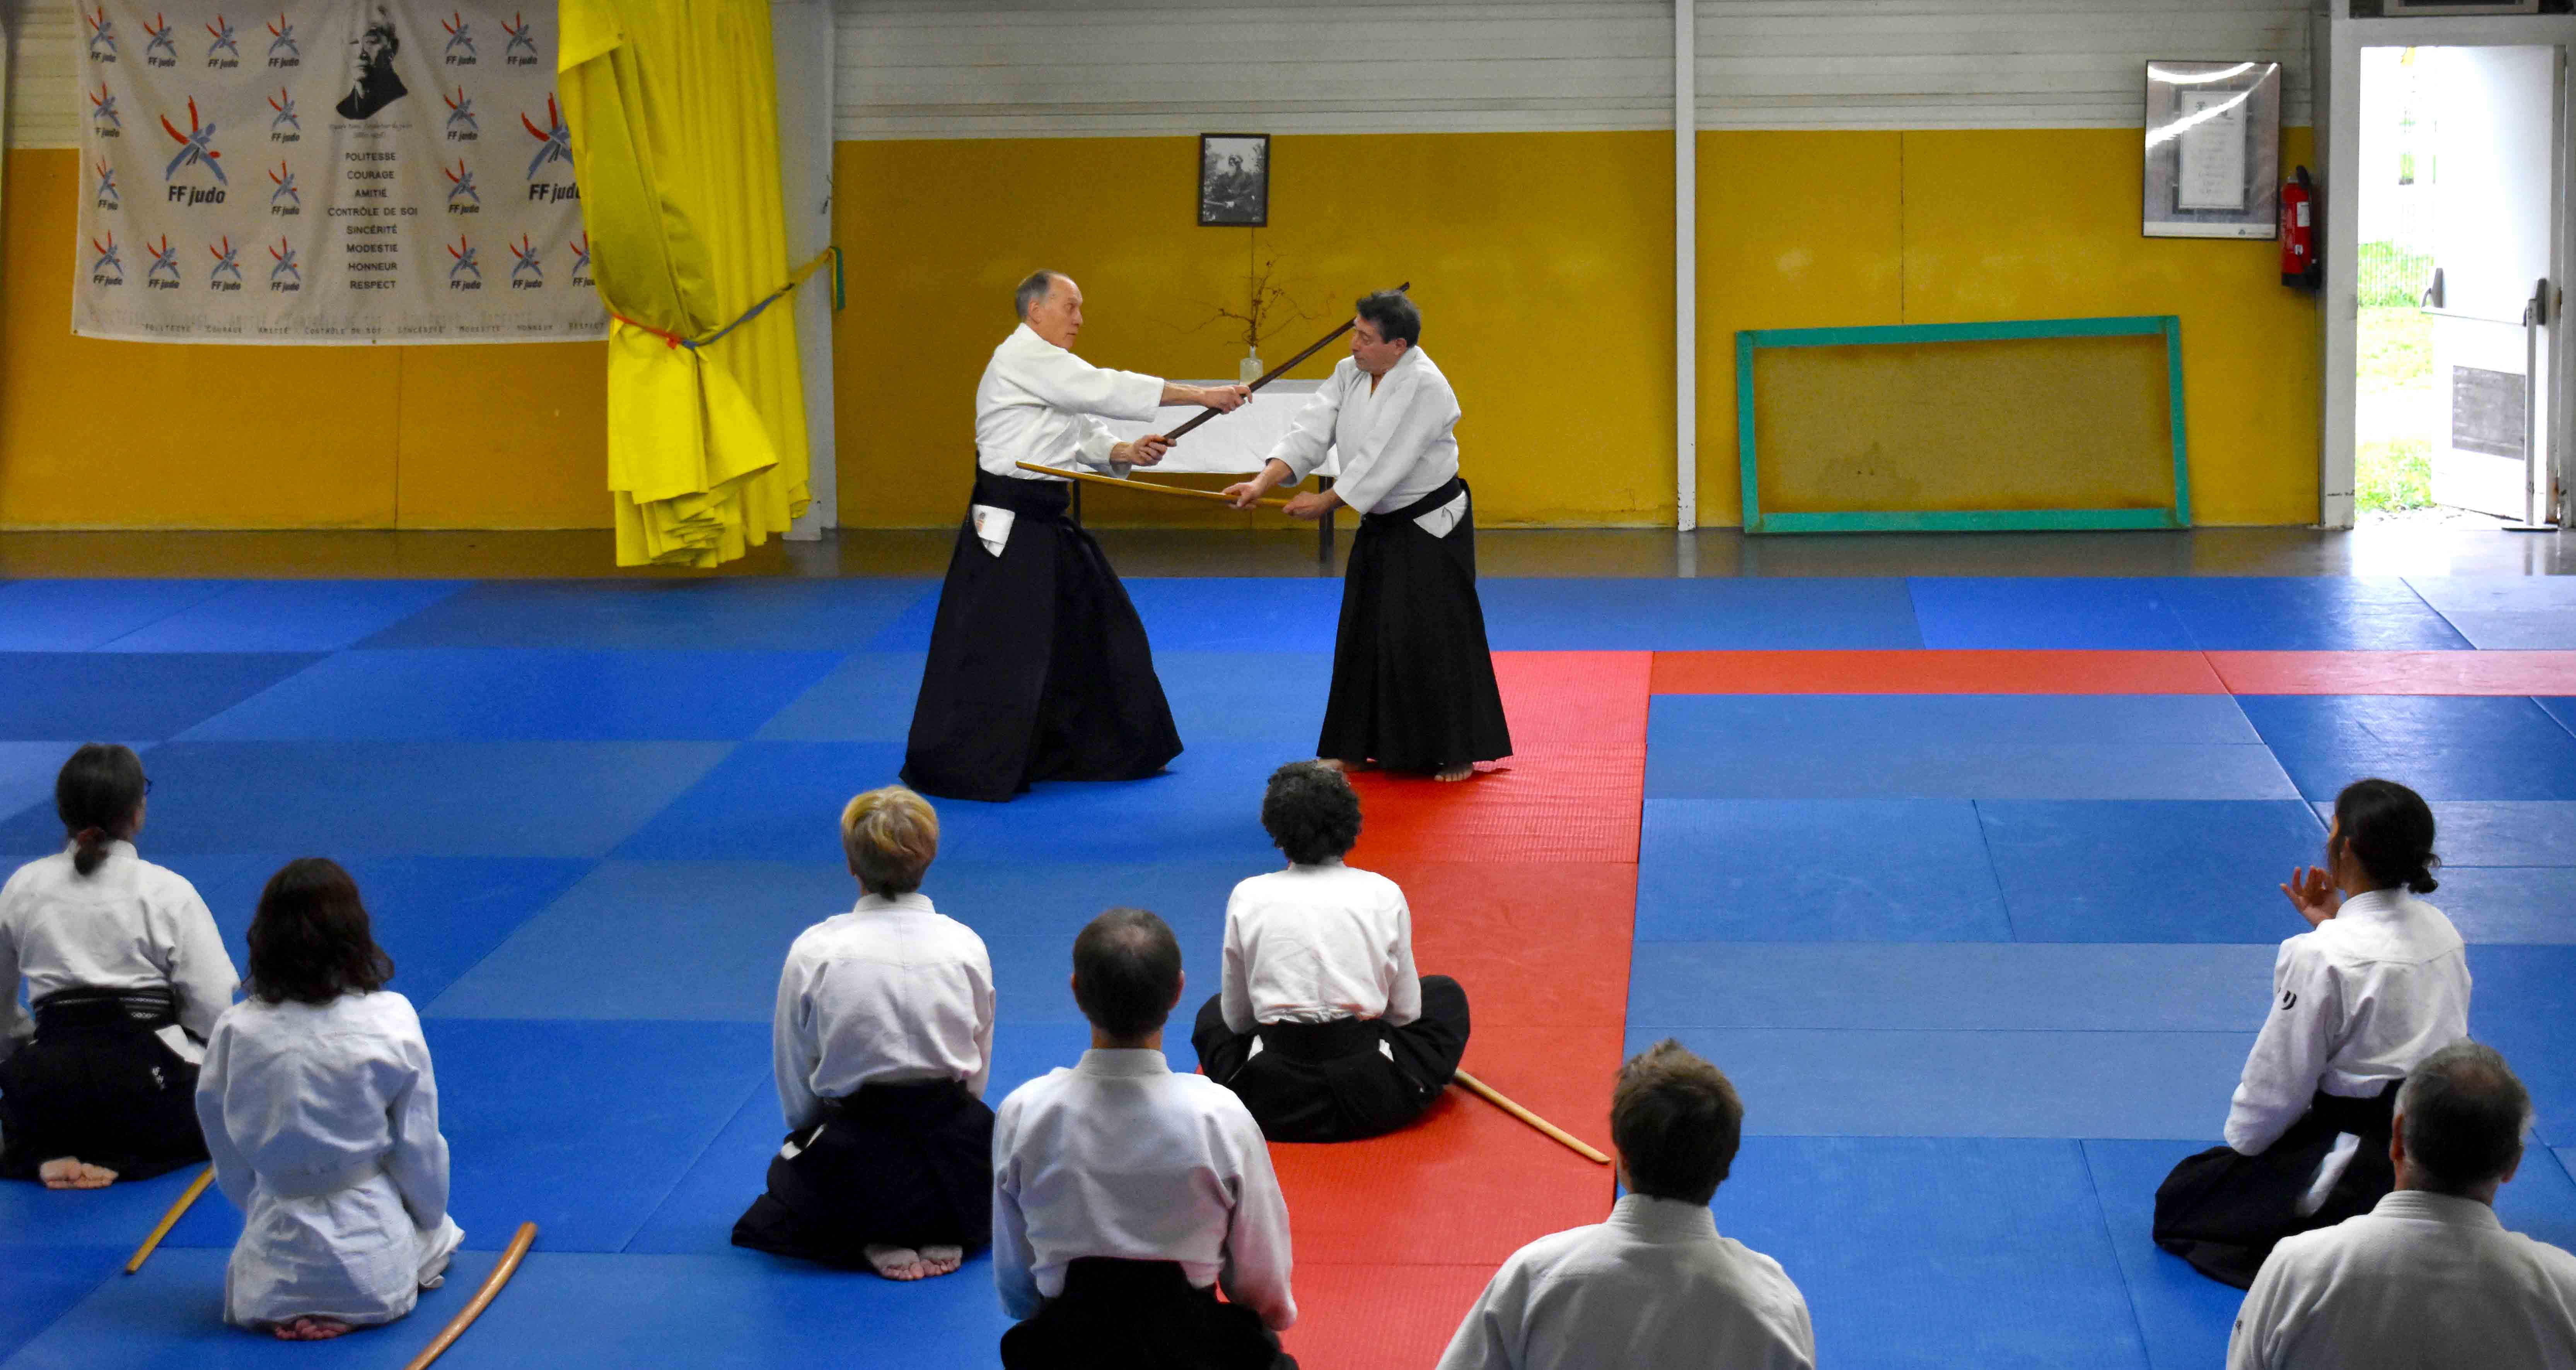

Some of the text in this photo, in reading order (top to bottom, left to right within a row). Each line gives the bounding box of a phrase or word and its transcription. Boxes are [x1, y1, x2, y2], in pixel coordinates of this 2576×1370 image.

[91, 51, 101, 60] FF
[148, 57, 157, 66] FF
[208, 58, 218, 67] FF
[268, 58, 280, 67] FF
[445, 56, 458, 65] FF
[508, 56, 518, 65] FF
[271, 133, 281, 142] FF
[447, 131, 457, 140] FF
[346, 152, 396, 161] POLITESSE
[347, 171, 394, 179] COURAGE
[169, 185, 226, 206] FF judo
[529, 183, 550, 200] FF
[272, 206, 281, 214] FF
[384, 208, 396, 216] DE
[400, 207, 418, 215] SOI
[448, 205, 459, 213] FF
[346, 244, 398, 253] MODESTIE
[348, 262, 397, 271] HONNEUR
[93, 275, 105, 284] FF
[148, 279, 160, 288] FF
[513, 280, 523, 288] FF
[573, 277, 583, 287] FF
[212, 281, 222, 290] FF
[271, 282, 281, 291] FF
[350, 280, 396, 289] RESPECT
[451, 280, 461, 289] FF
